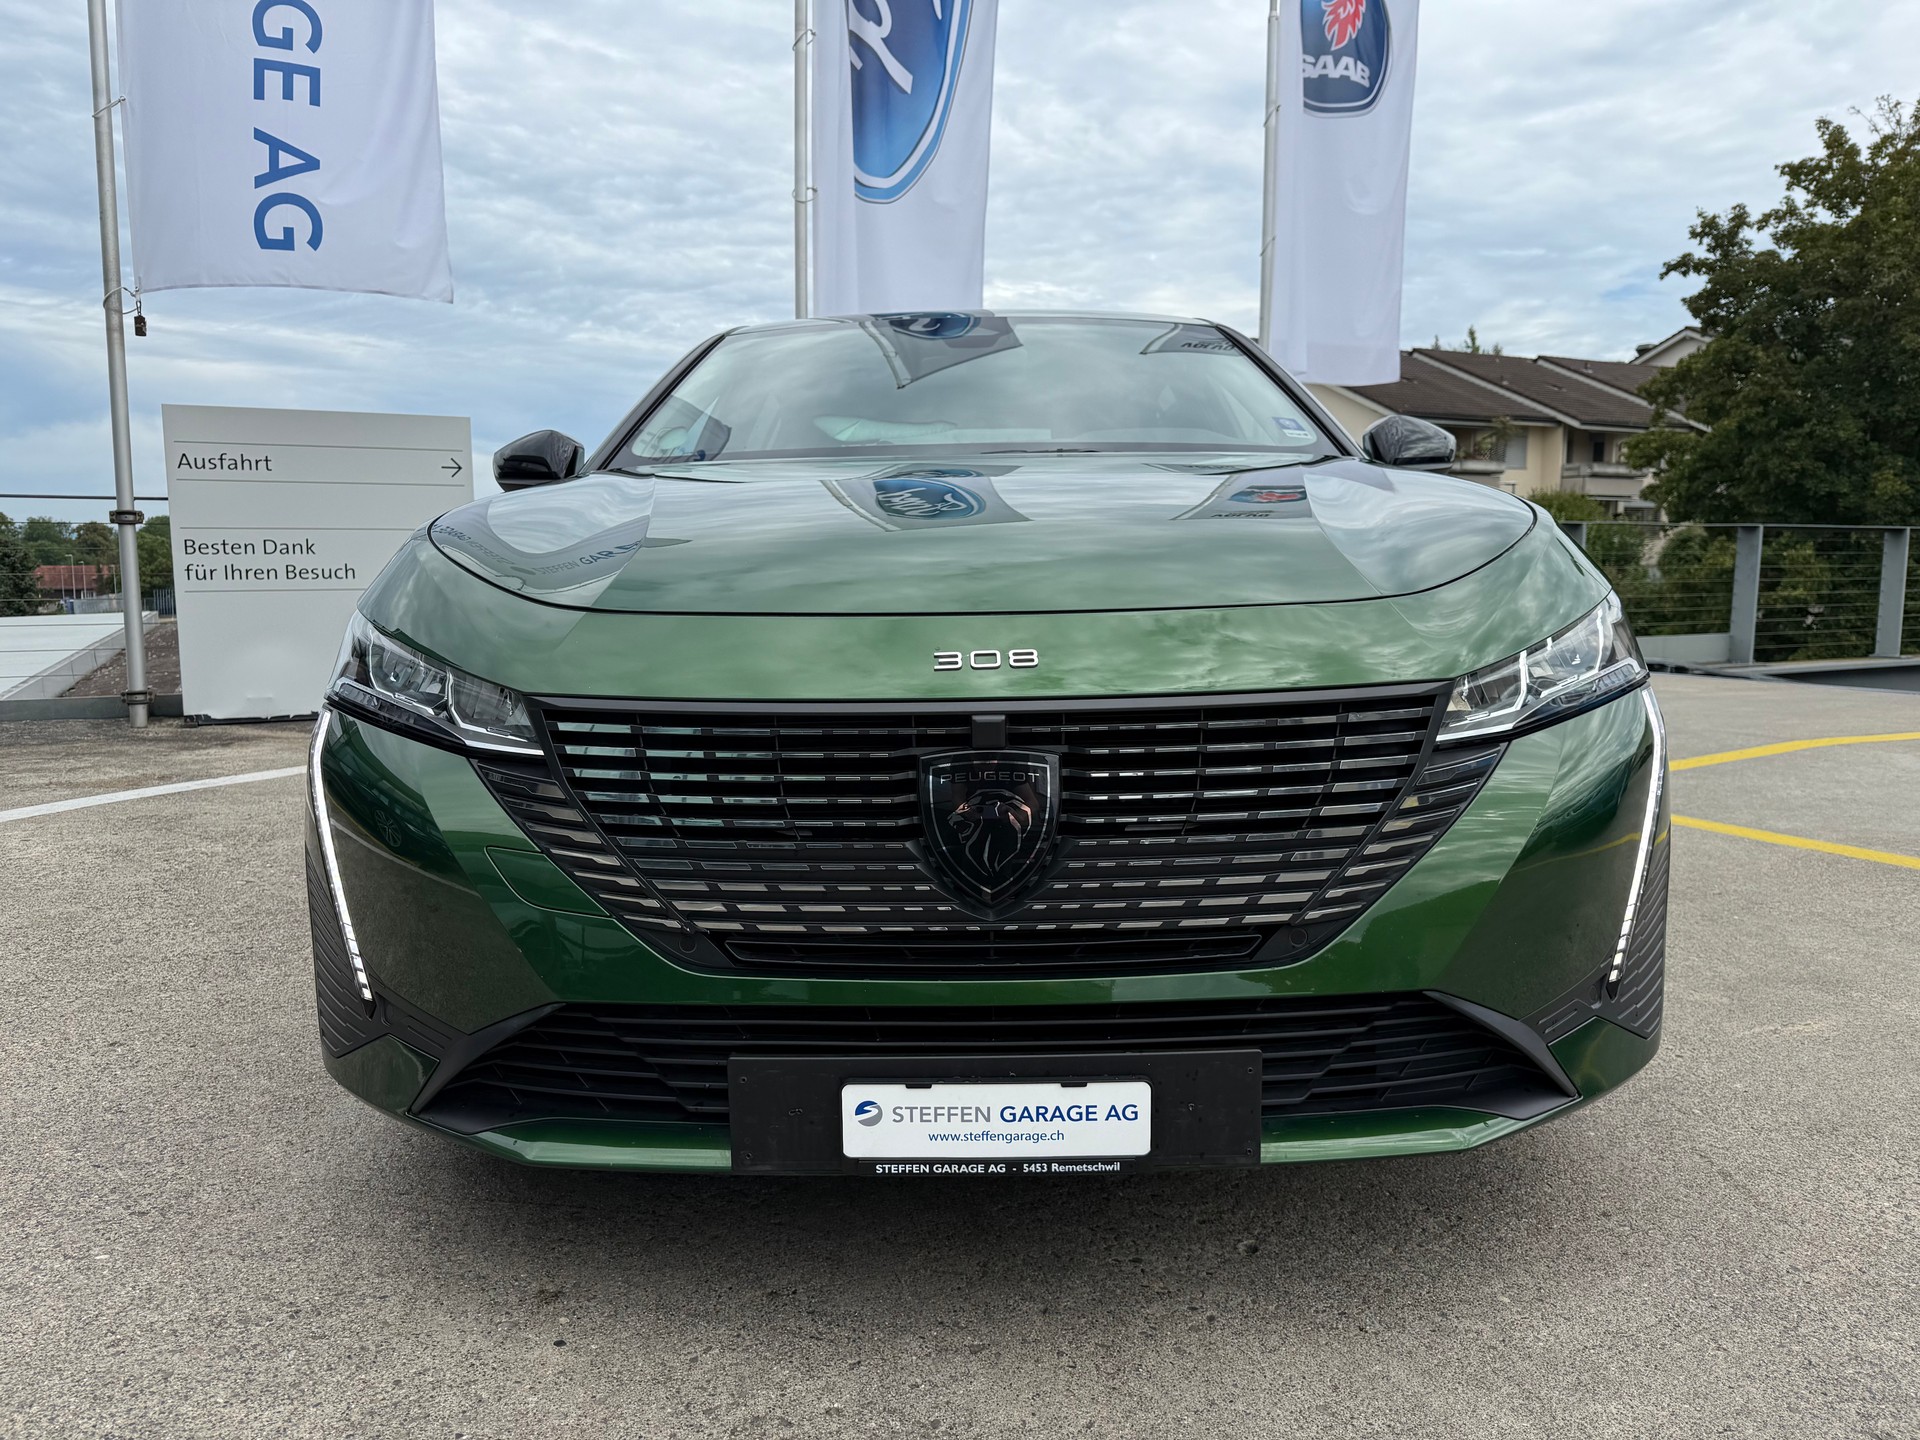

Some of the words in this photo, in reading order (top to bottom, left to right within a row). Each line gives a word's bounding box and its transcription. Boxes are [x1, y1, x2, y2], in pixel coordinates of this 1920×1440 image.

[1302, 54, 1370, 88] SAAB
[253, 126, 323, 251] AG
[177, 453, 273, 472] Ausfahrt
[184, 539, 256, 555] Besten
[263, 538, 316, 555] Dank
[184, 564, 217, 581] für
[224, 564, 278, 581] Ihren
[285, 563, 356, 580] Besuch
[934, 648, 1039, 670] 308
[940, 771, 1040, 784] PEUGEOT
[892, 1106, 991, 1123] STEFFEN
[999, 1105, 1098, 1123] GARAGE
[1104, 1104, 1139, 1121] AG
[928, 1130, 1064, 1144] www.steffengarage.ch
[875, 1164, 930, 1174] STEFFEN
[932, 1164, 985, 1174] GARAGE
[987, 1163, 1006, 1173] AG
[1023, 1163, 1048, 1173] 5453
[1051, 1161, 1121, 1173] Remetschwil
